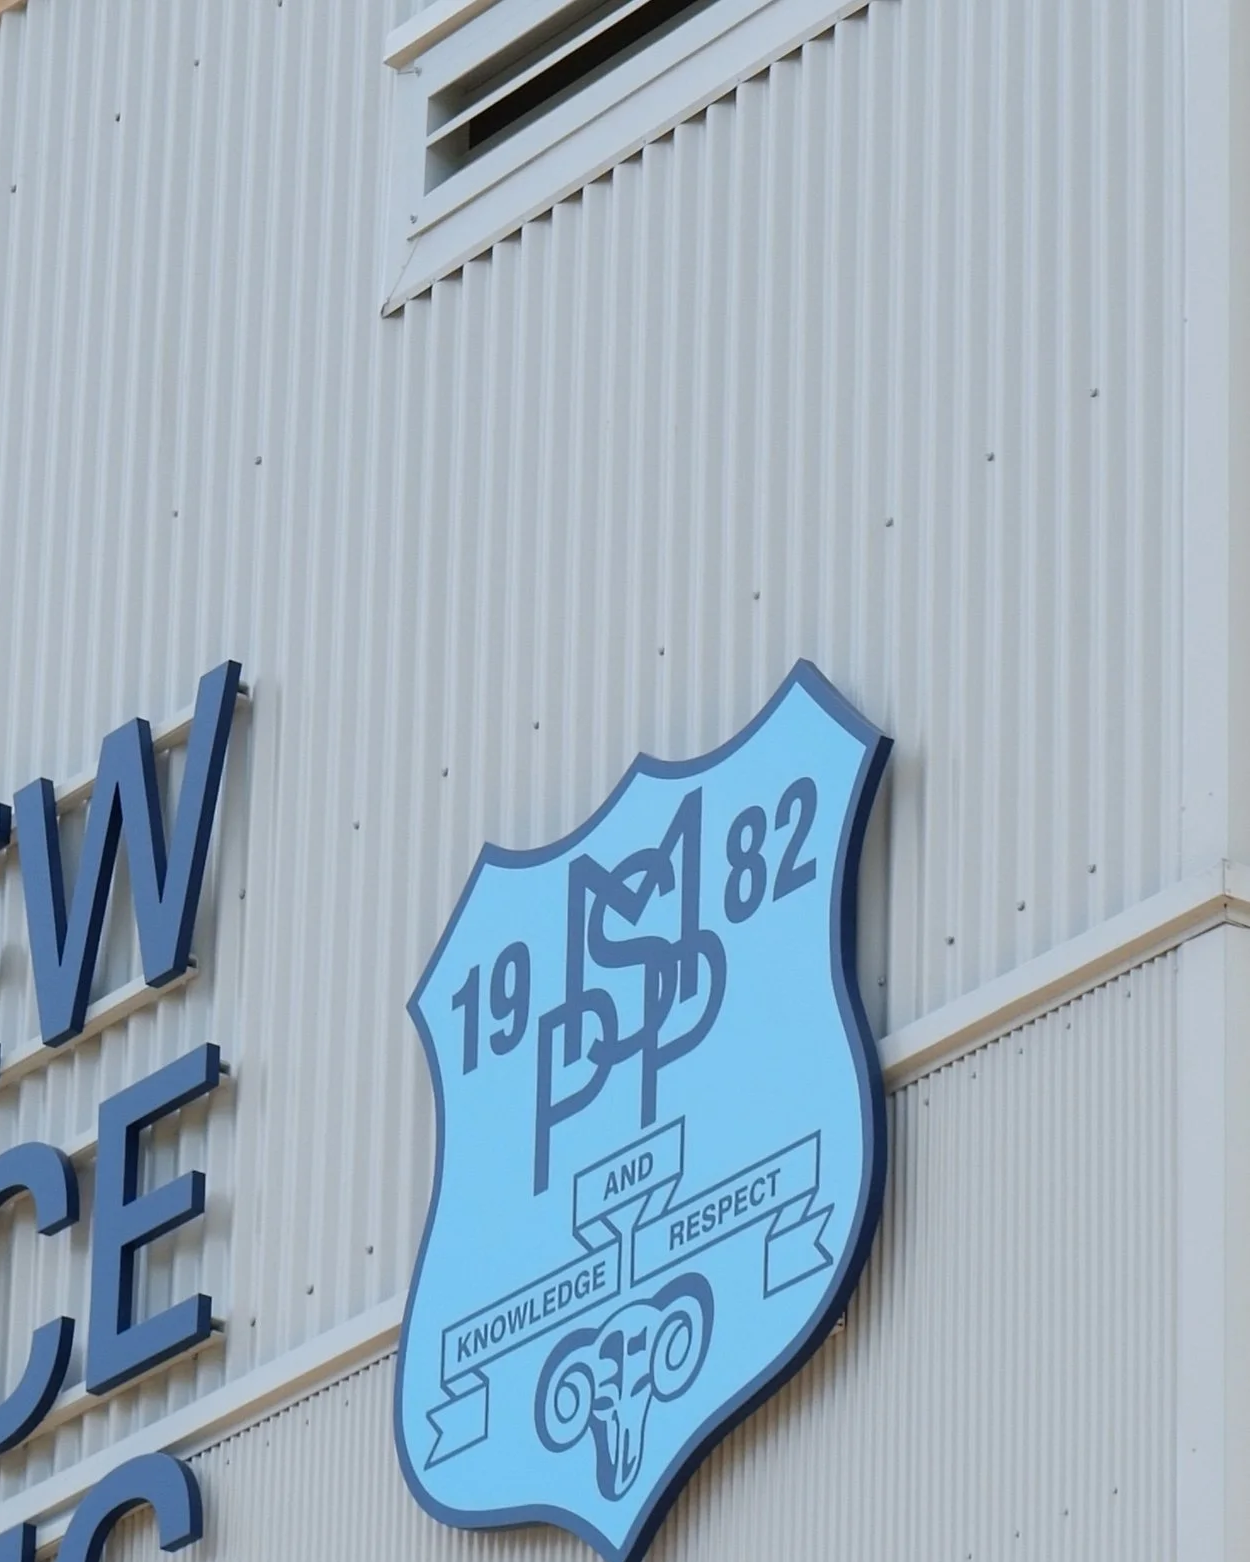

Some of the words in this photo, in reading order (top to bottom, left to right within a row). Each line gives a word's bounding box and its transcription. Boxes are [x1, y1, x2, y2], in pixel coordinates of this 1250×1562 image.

[452, 941, 530, 1075] 19
[724, 776, 817, 924] 82
[603, 1151, 654, 1200] AND
[669, 1169, 781, 1250] RESPECT
[457, 1261, 606, 1363] KNOWLEDGE
